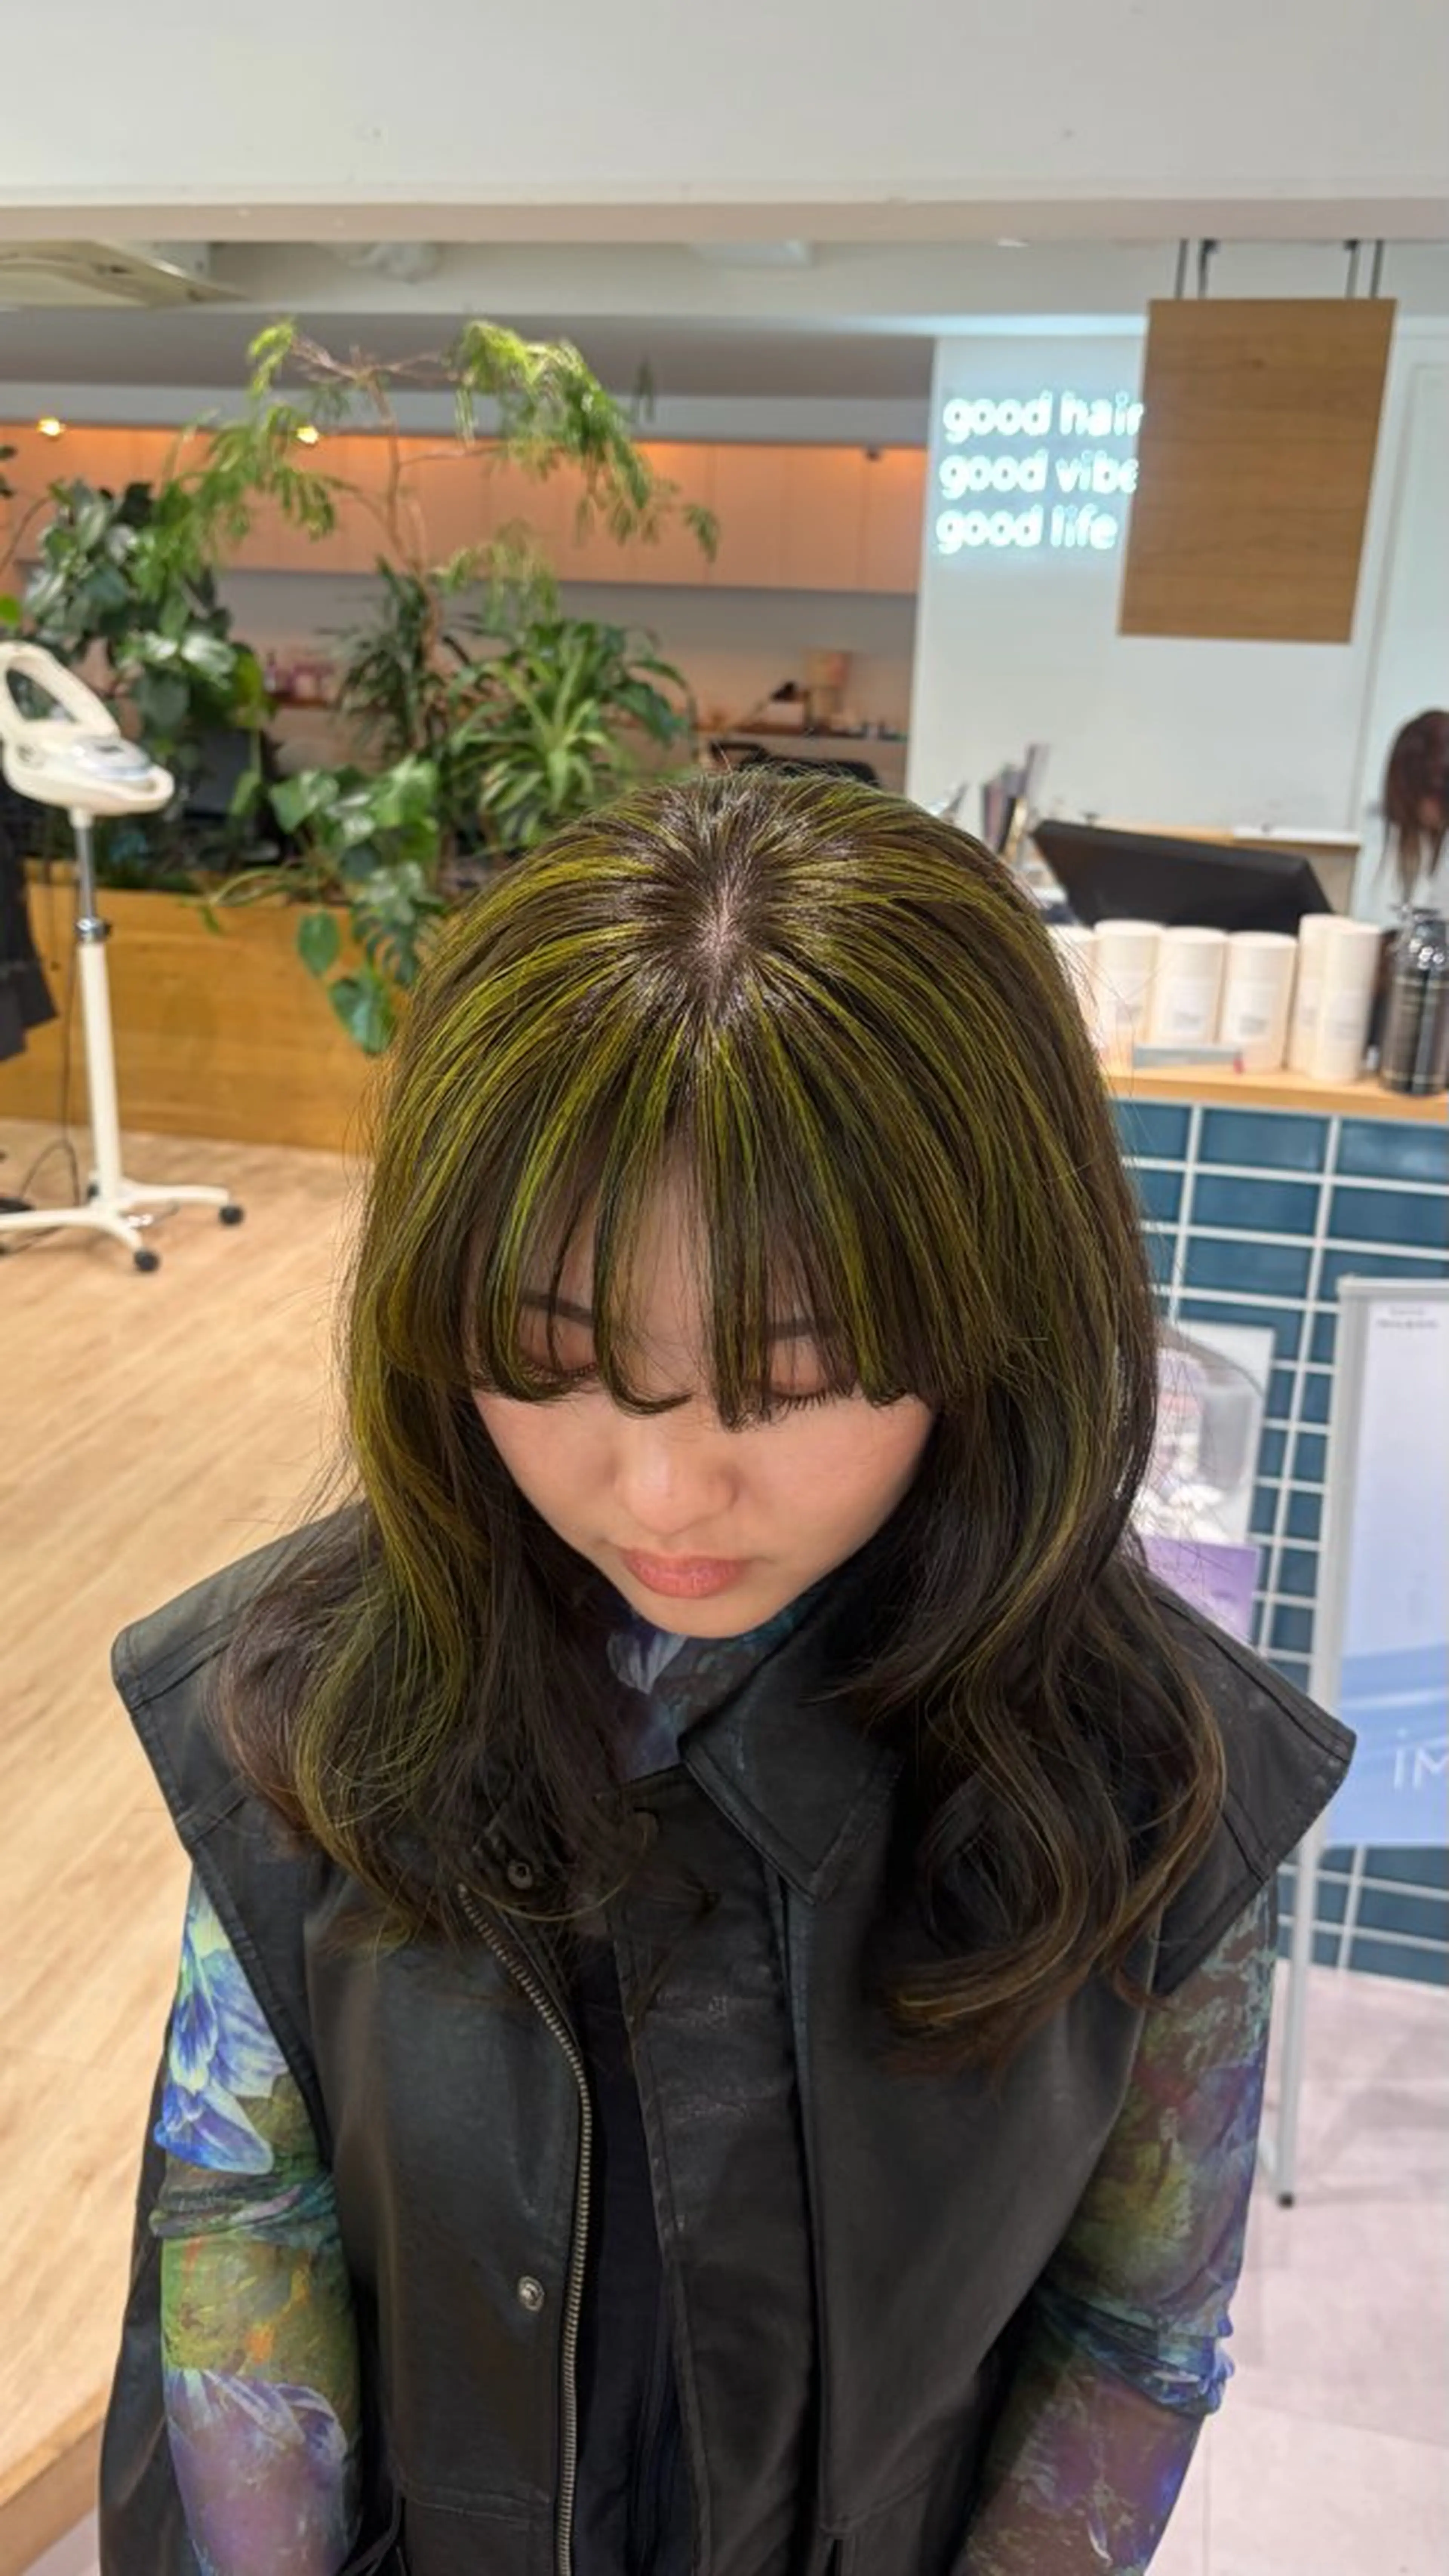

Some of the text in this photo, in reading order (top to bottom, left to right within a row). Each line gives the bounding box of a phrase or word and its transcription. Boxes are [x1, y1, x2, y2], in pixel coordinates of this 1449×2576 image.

[943, 390, 1144, 443] good hair
[939, 448, 1048, 499] good
[936, 503, 1118, 554] good life
